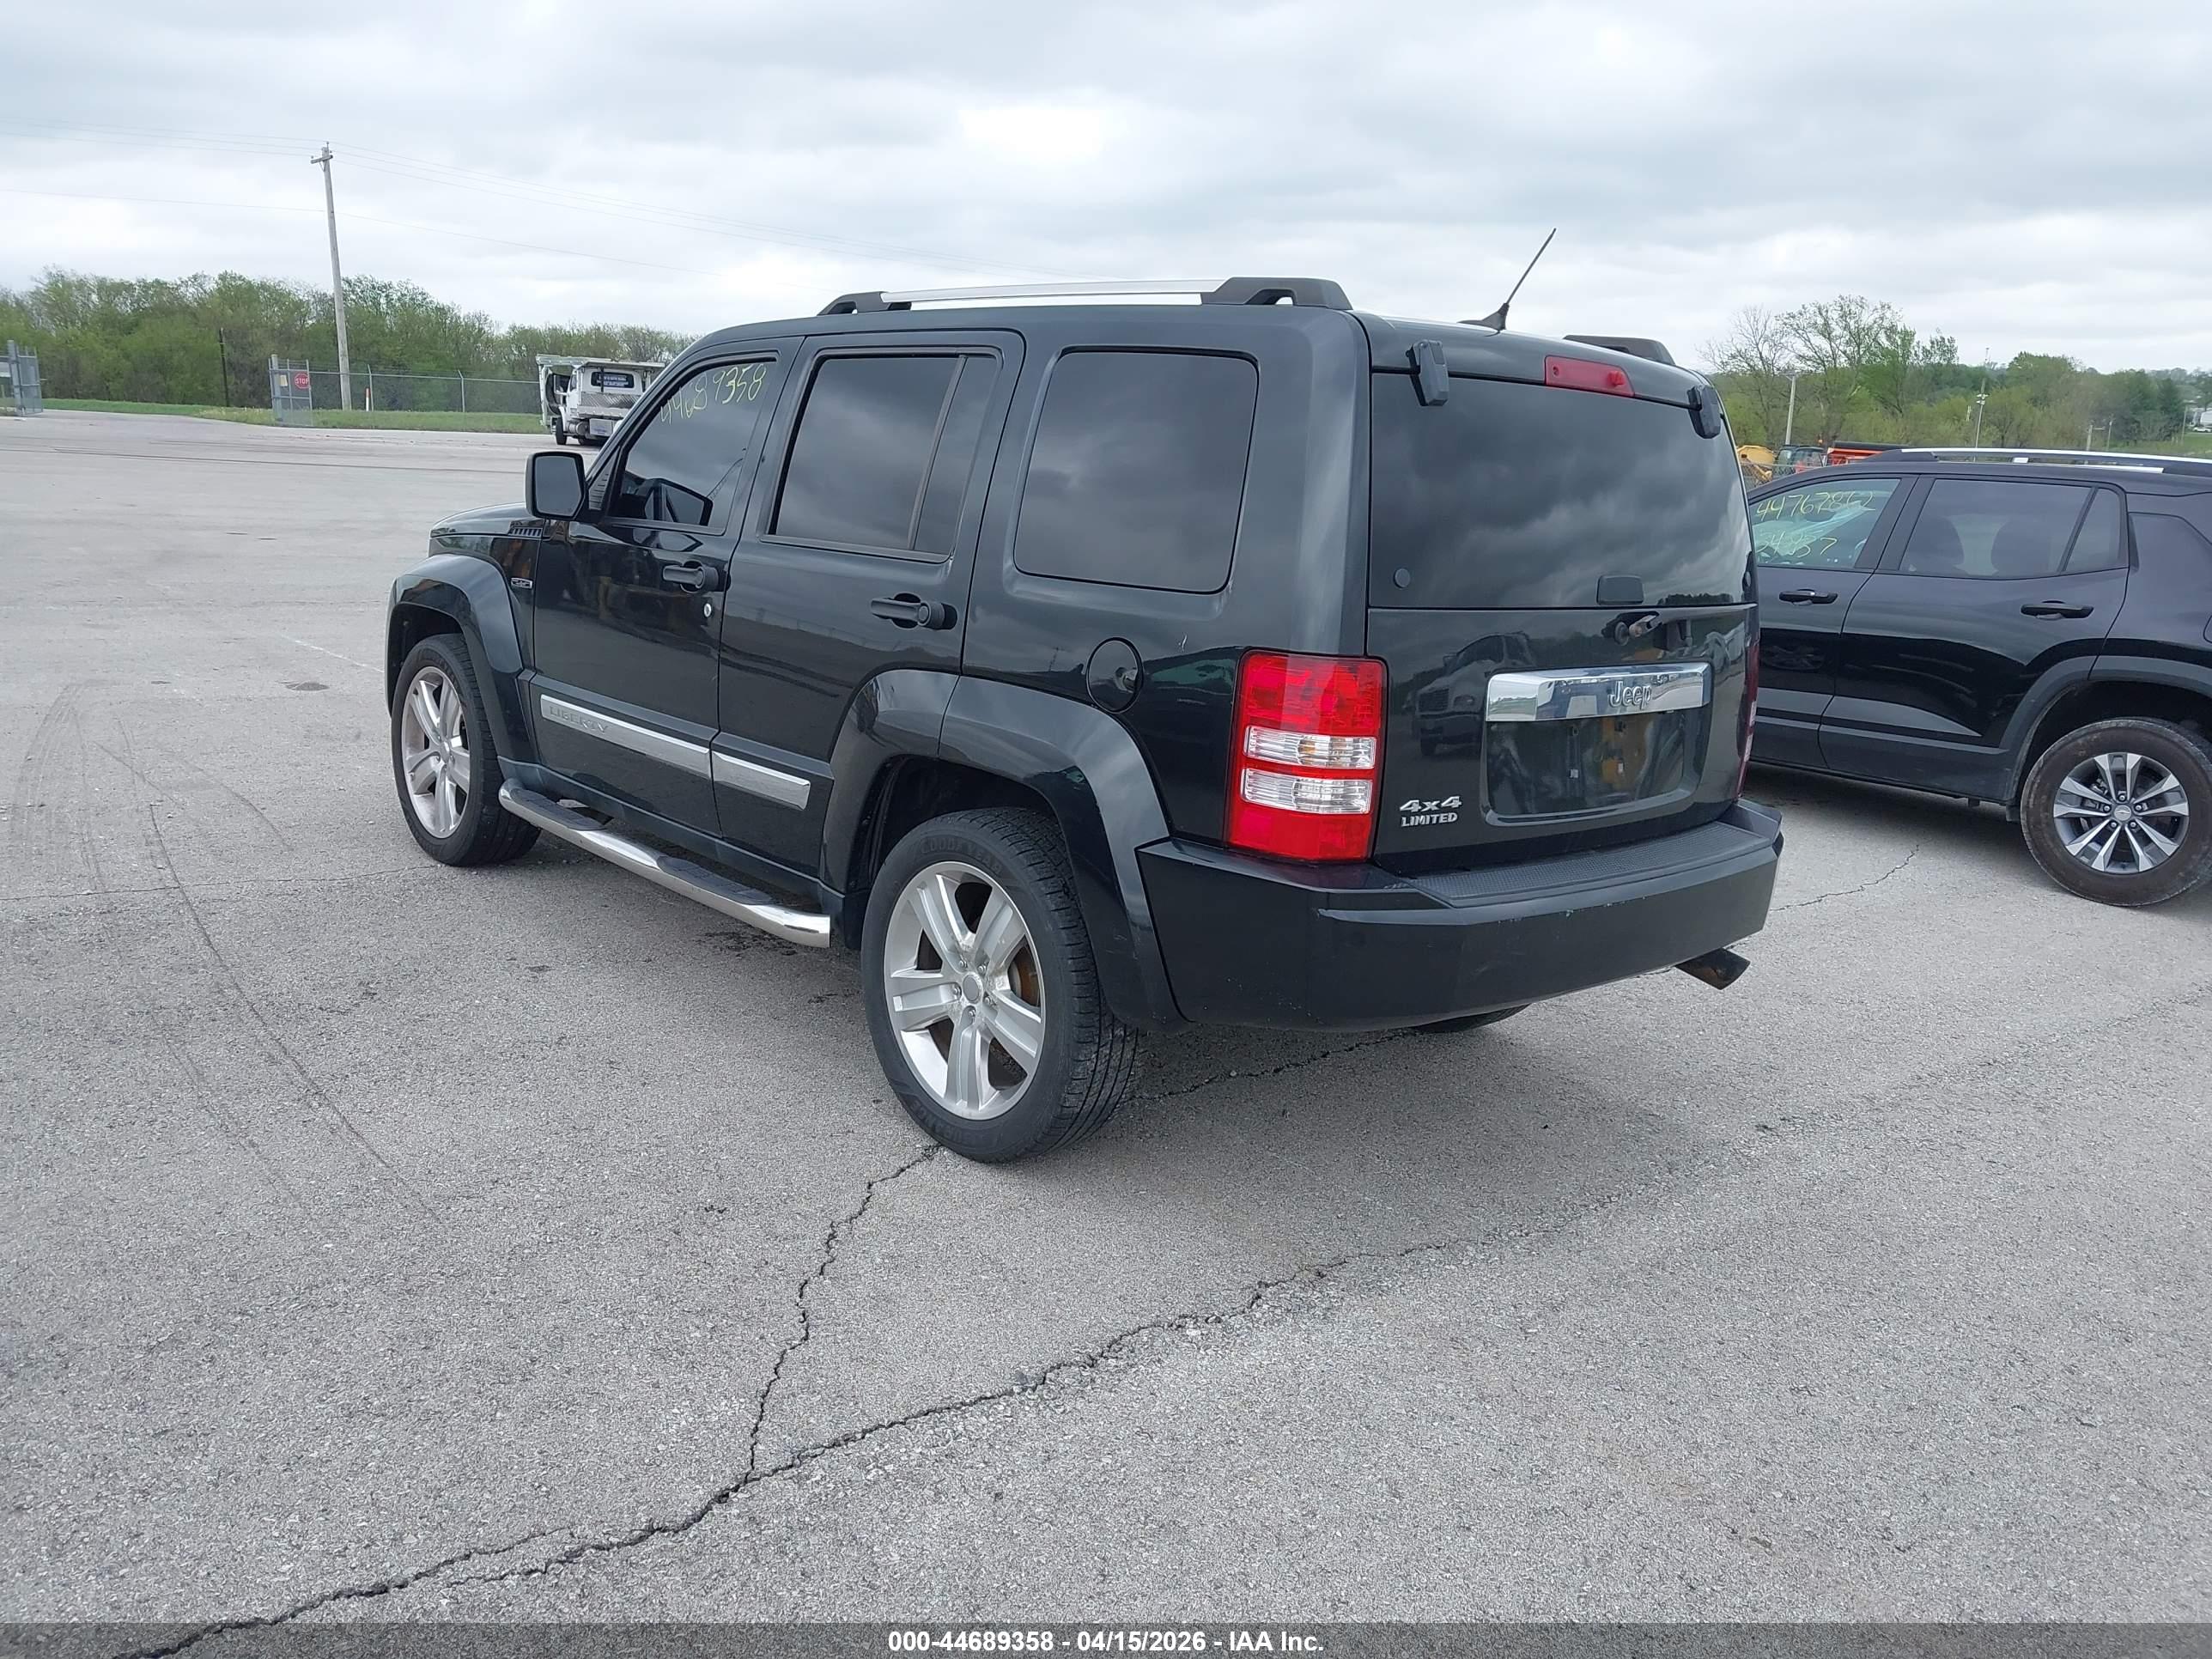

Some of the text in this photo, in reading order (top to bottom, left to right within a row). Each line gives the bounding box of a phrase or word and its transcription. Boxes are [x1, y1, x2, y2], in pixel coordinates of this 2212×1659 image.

[1608, 680, 1652, 710] Jeep
[550, 705, 609, 734] LIBERTY
[1400, 795, 1462, 812] 4x4
[1401, 812, 1458, 827] LIMITED
